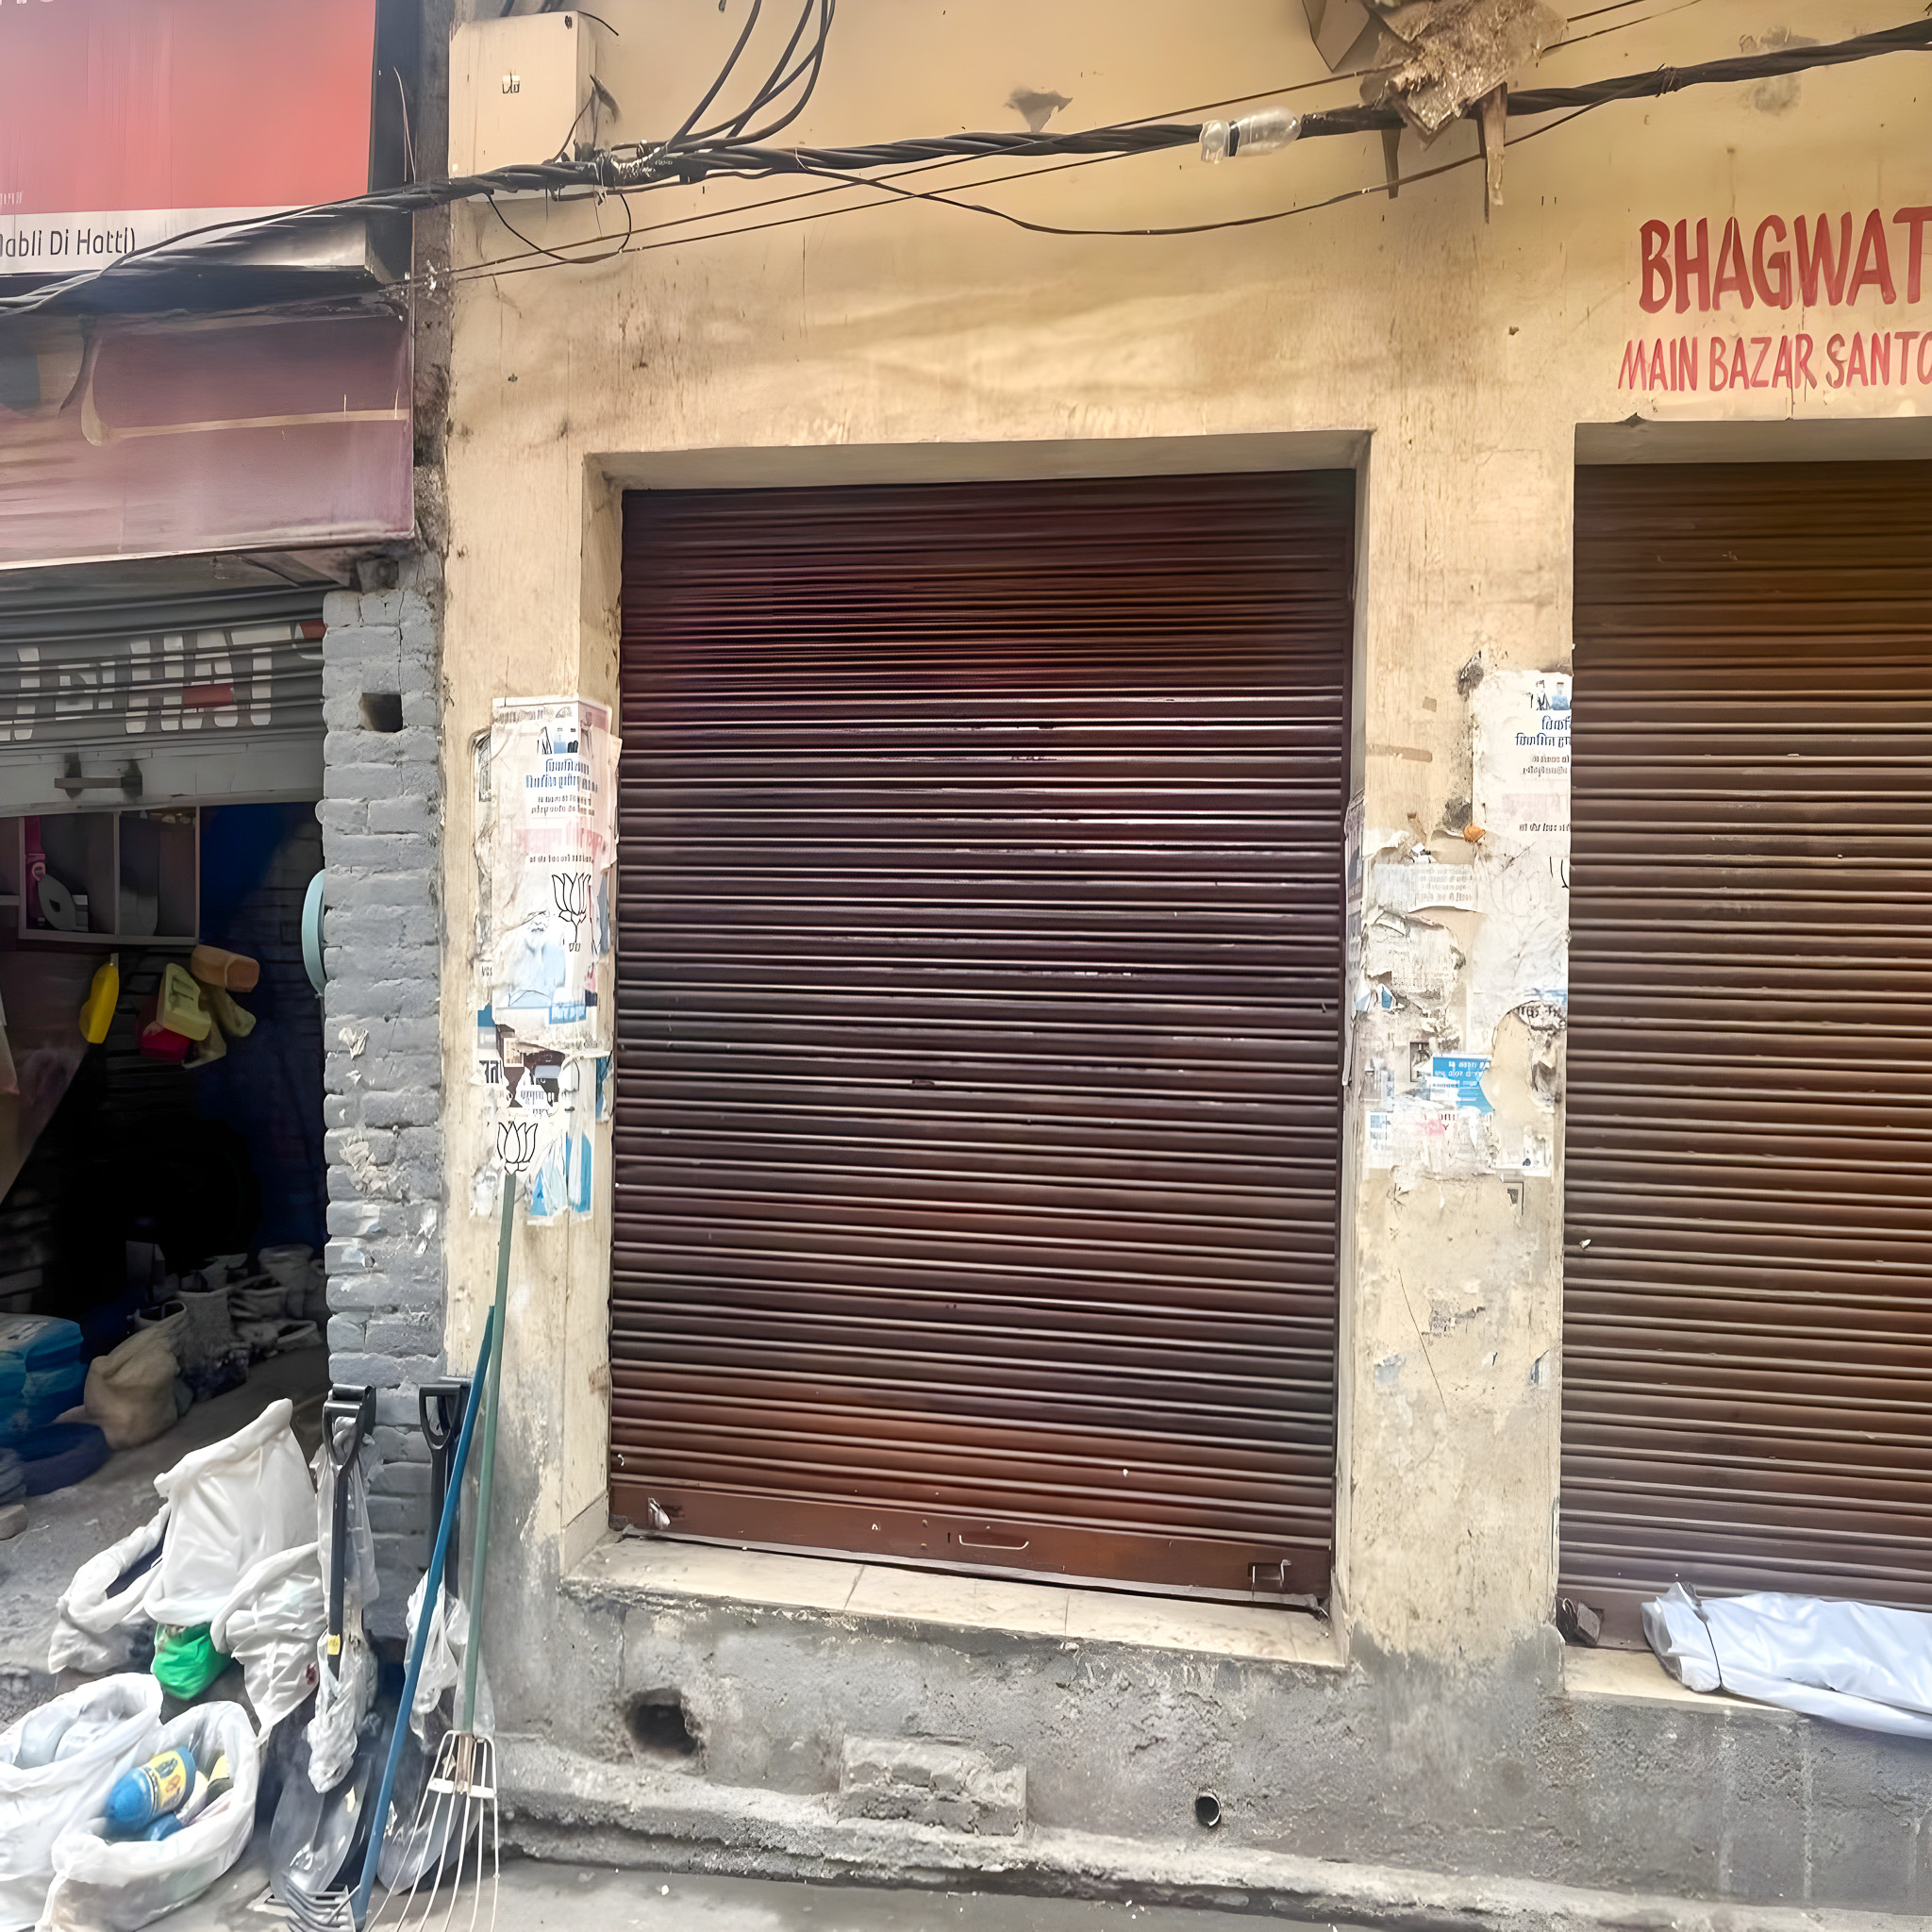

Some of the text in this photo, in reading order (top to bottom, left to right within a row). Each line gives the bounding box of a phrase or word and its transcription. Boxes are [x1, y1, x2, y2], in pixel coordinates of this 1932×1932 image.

[0, 229, 42, 258] abli
[50, 228, 69, 256] Di
[1639, 206, 1932, 314] BHAGWAT
[1618, 334, 1697, 391] MAIN
[1709, 333, 1817, 391] BAZAR
